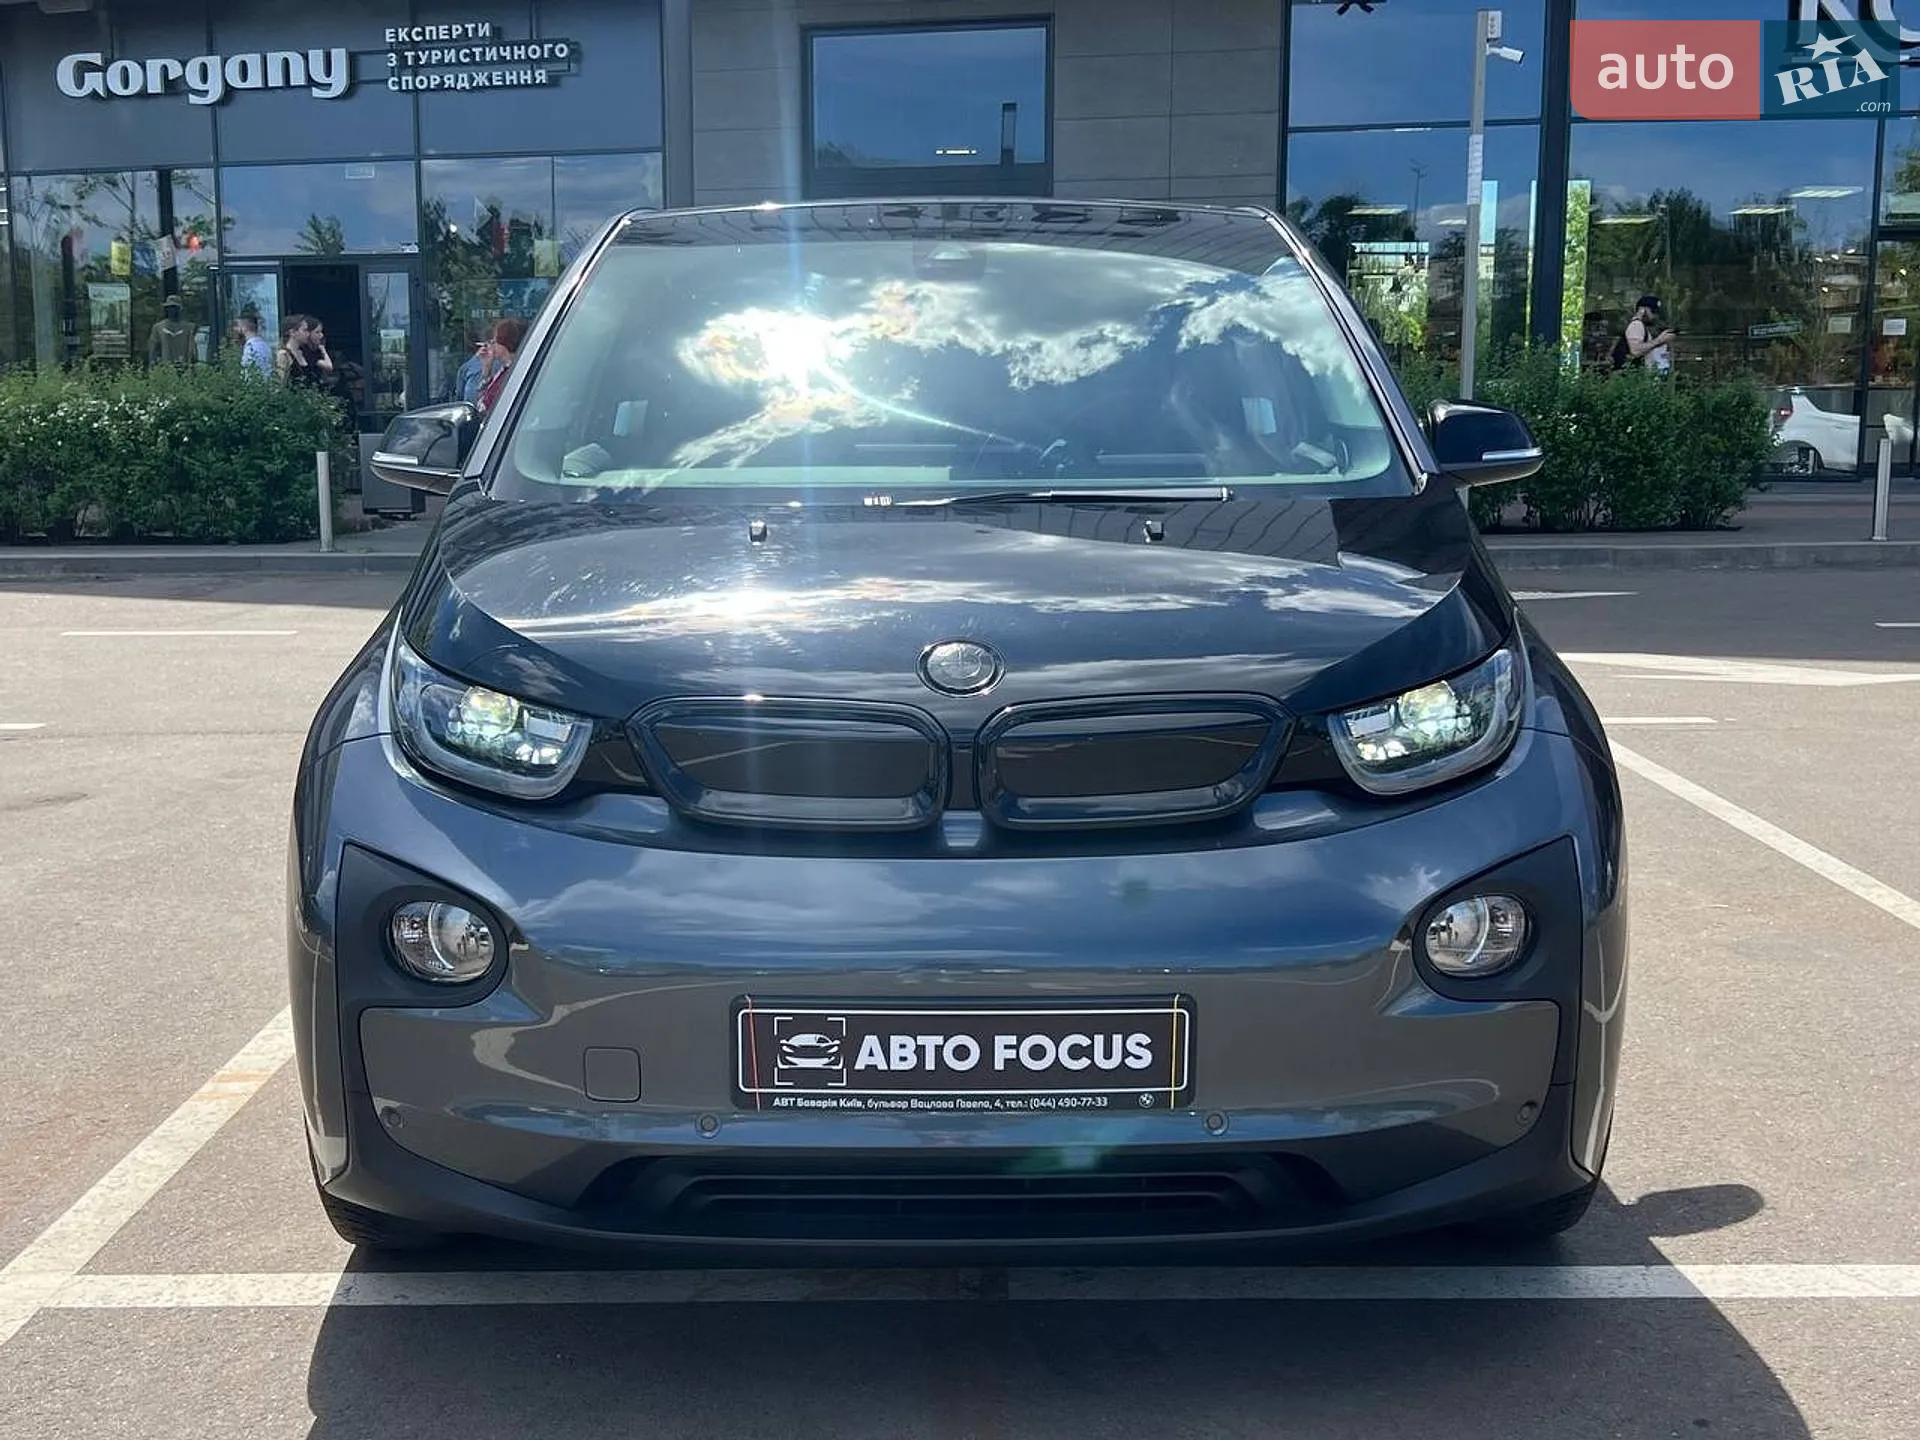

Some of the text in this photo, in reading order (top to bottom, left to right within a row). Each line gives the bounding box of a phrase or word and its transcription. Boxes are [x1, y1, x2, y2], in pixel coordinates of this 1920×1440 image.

[385, 22, 490, 42] ЕКСПЕРТИ
[404, 43, 569, 66] ТУРИСТИЧНОГО
[56, 48, 347, 105] Gorgany
[388, 69, 547, 91] СПОРЯДЖЕННЯ
[854, 1033, 1152, 1071] АВТО FOCUS
[1029, 1097, 1056, 1110] (044)
[1058, 1096, 1108, 1108] 490-77-33
